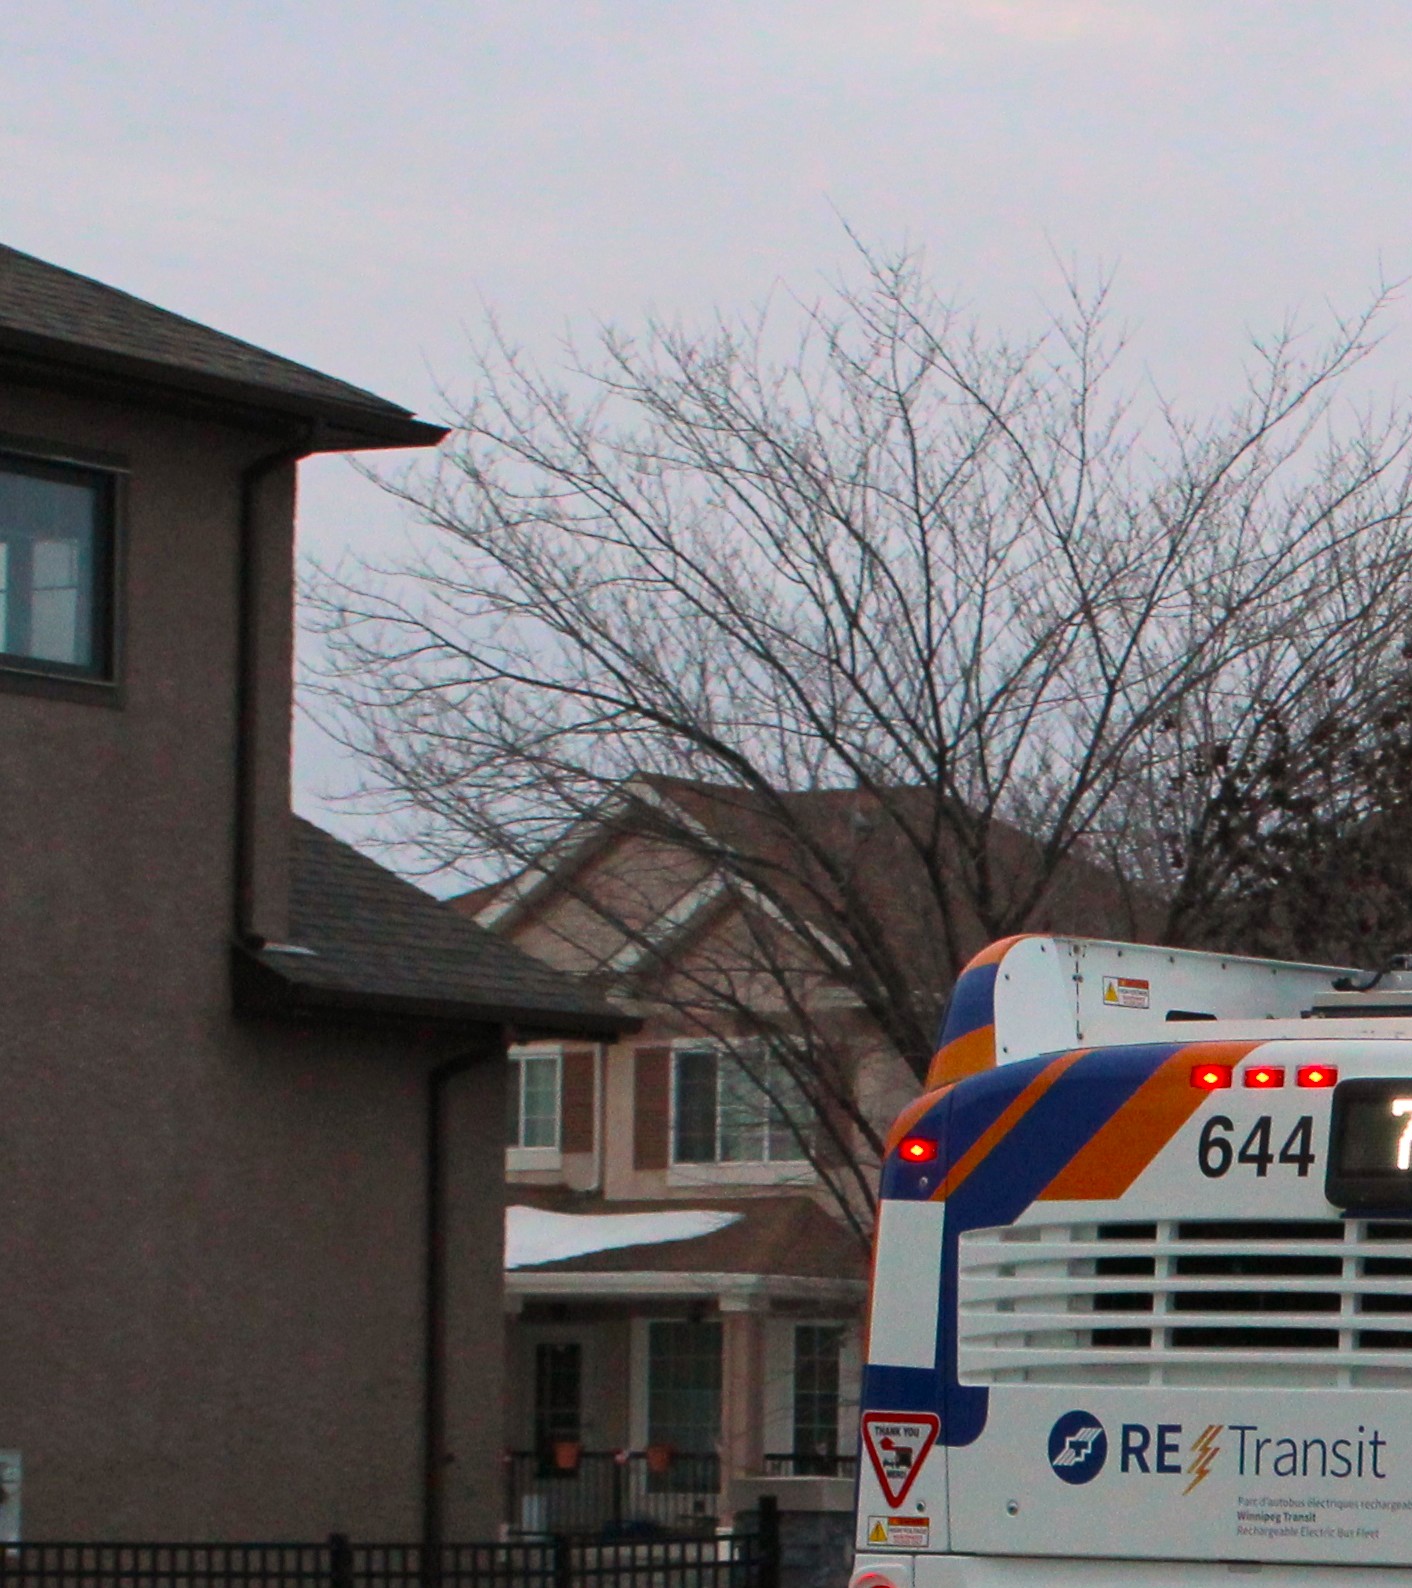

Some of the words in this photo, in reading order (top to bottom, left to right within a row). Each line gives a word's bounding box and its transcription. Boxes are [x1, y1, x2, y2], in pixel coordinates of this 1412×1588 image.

[1197, 1115, 1316, 1178] 644
[875, 1426, 901, 1437] THANK
[903, 1426, 920, 1438] YOU
[1120, 1423, 1183, 1475] RE
[1228, 1424, 1387, 1479] Transit
[1238, 1496, 1257, 1507] Parc
[1236, 1511, 1282, 1524] Winnipeg
[1283, 1512, 1316, 1523] Transit
[1237, 1525, 1298, 1539] Rechargeable
[1300, 1526, 1335, 1538] Electric
[1337, 1528, 1353, 1538] Bus
[1356, 1528, 1380, 1539] Fleet
